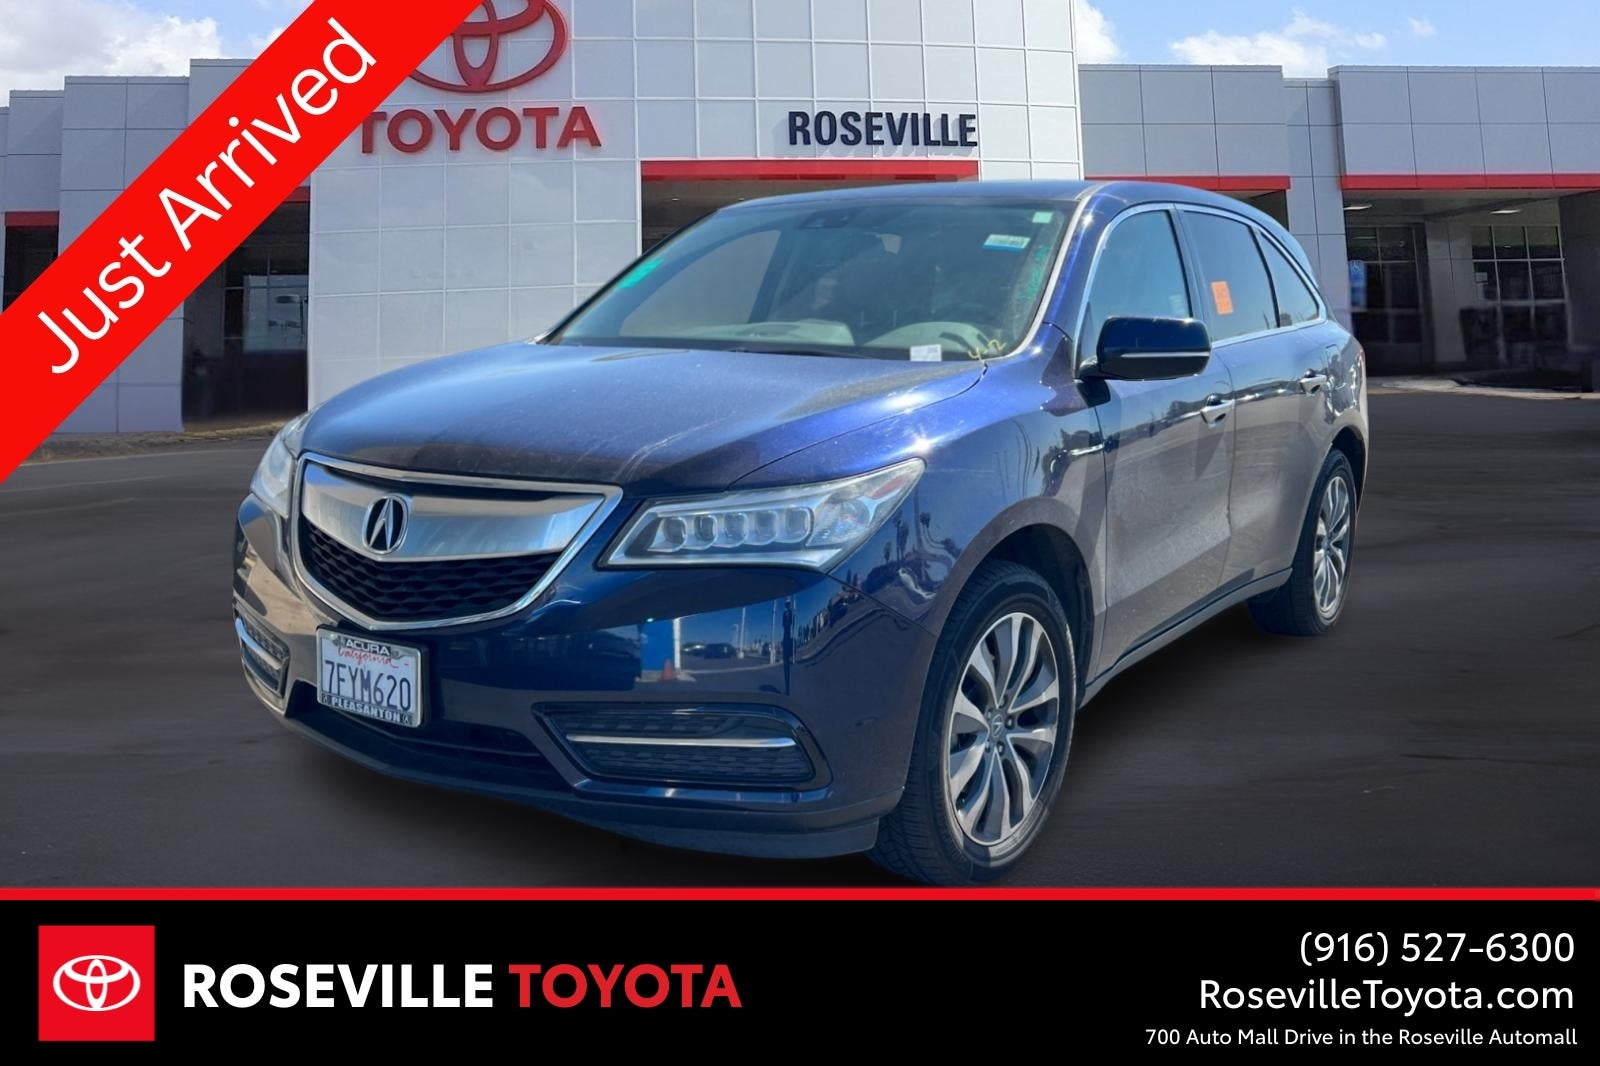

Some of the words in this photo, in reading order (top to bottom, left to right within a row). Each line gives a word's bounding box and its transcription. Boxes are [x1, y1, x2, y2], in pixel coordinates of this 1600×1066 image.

[361, 106, 601, 154] TOYOTA
[788, 110, 978, 147] ROSEVILLE
[345, 639, 391, 656] ACURA
[325, 660, 411, 711] 7FYM620
[331, 697, 401, 723] PLEASANTON
